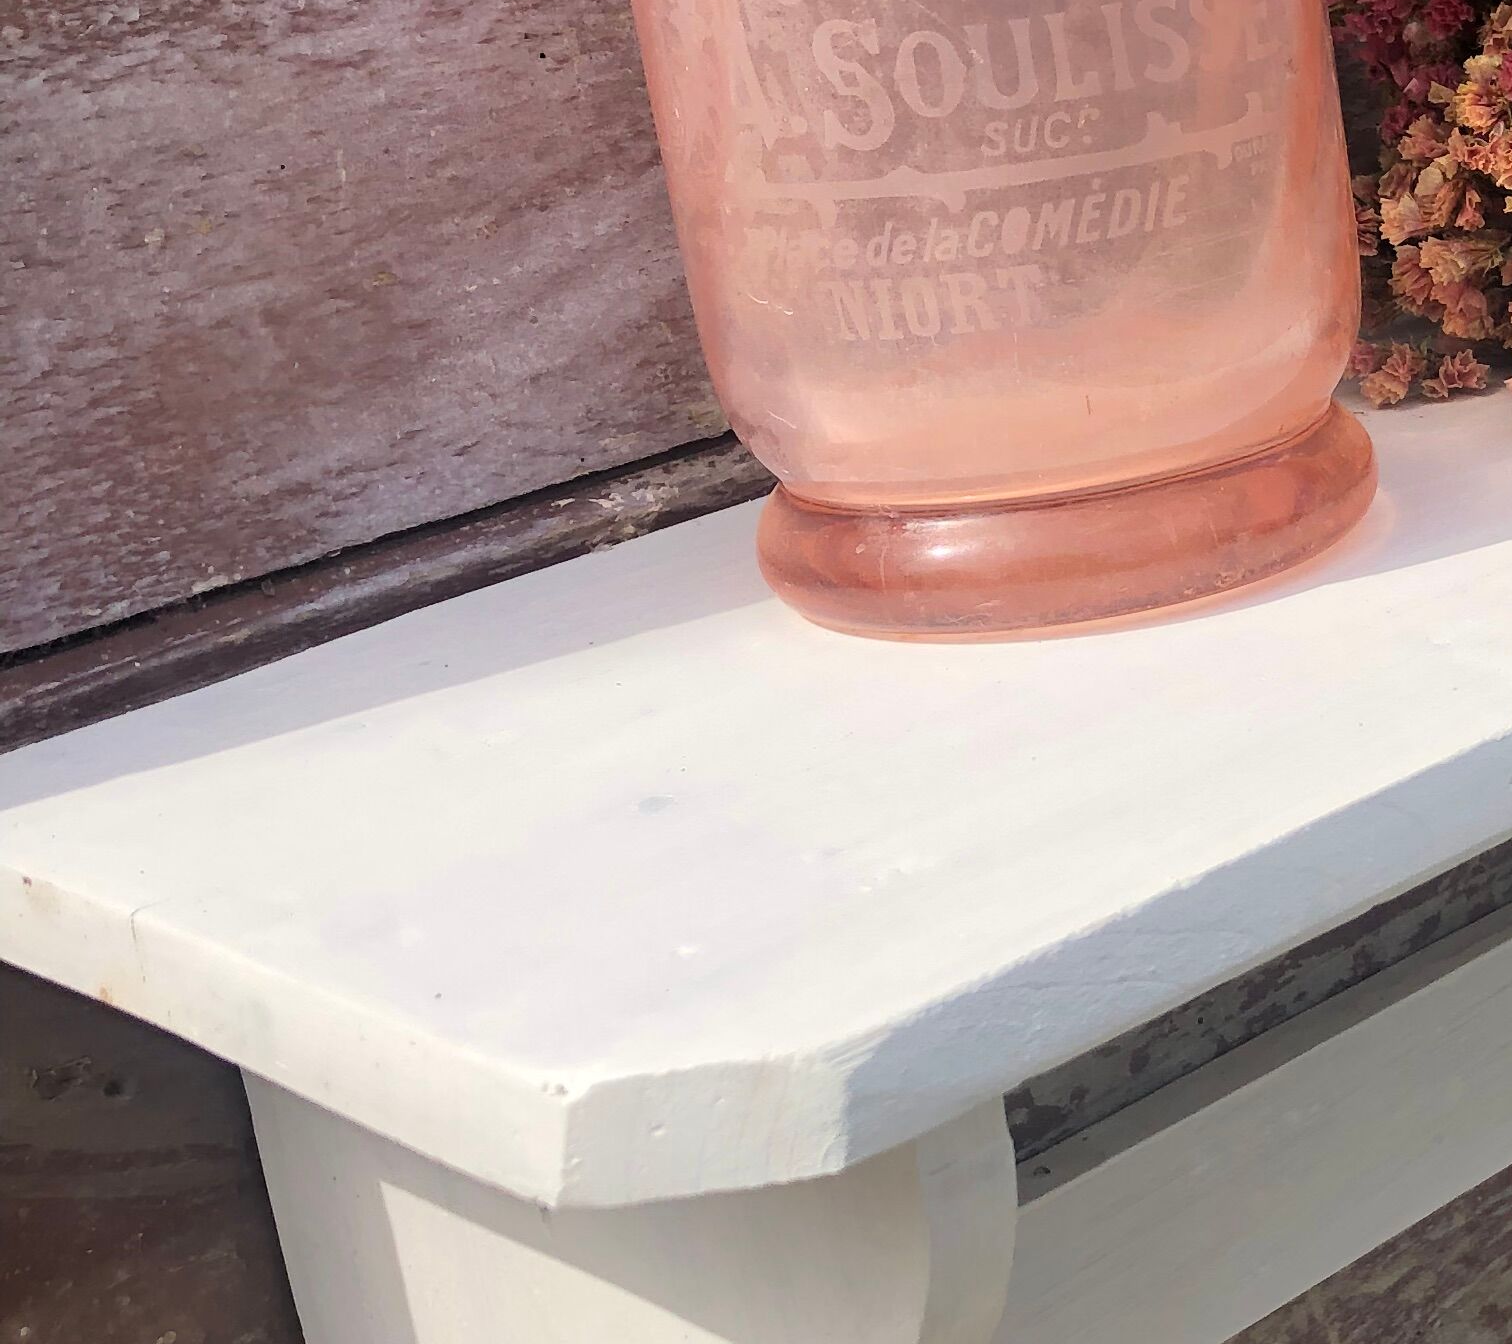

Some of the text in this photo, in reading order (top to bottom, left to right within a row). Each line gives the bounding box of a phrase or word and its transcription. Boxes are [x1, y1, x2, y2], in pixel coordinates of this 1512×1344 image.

[866, 220, 918, 268] de
[922, 217, 960, 262] la
[966, 176, 1188, 258] COMÉDIE
[820, 263, 1045, 343] NIORT
